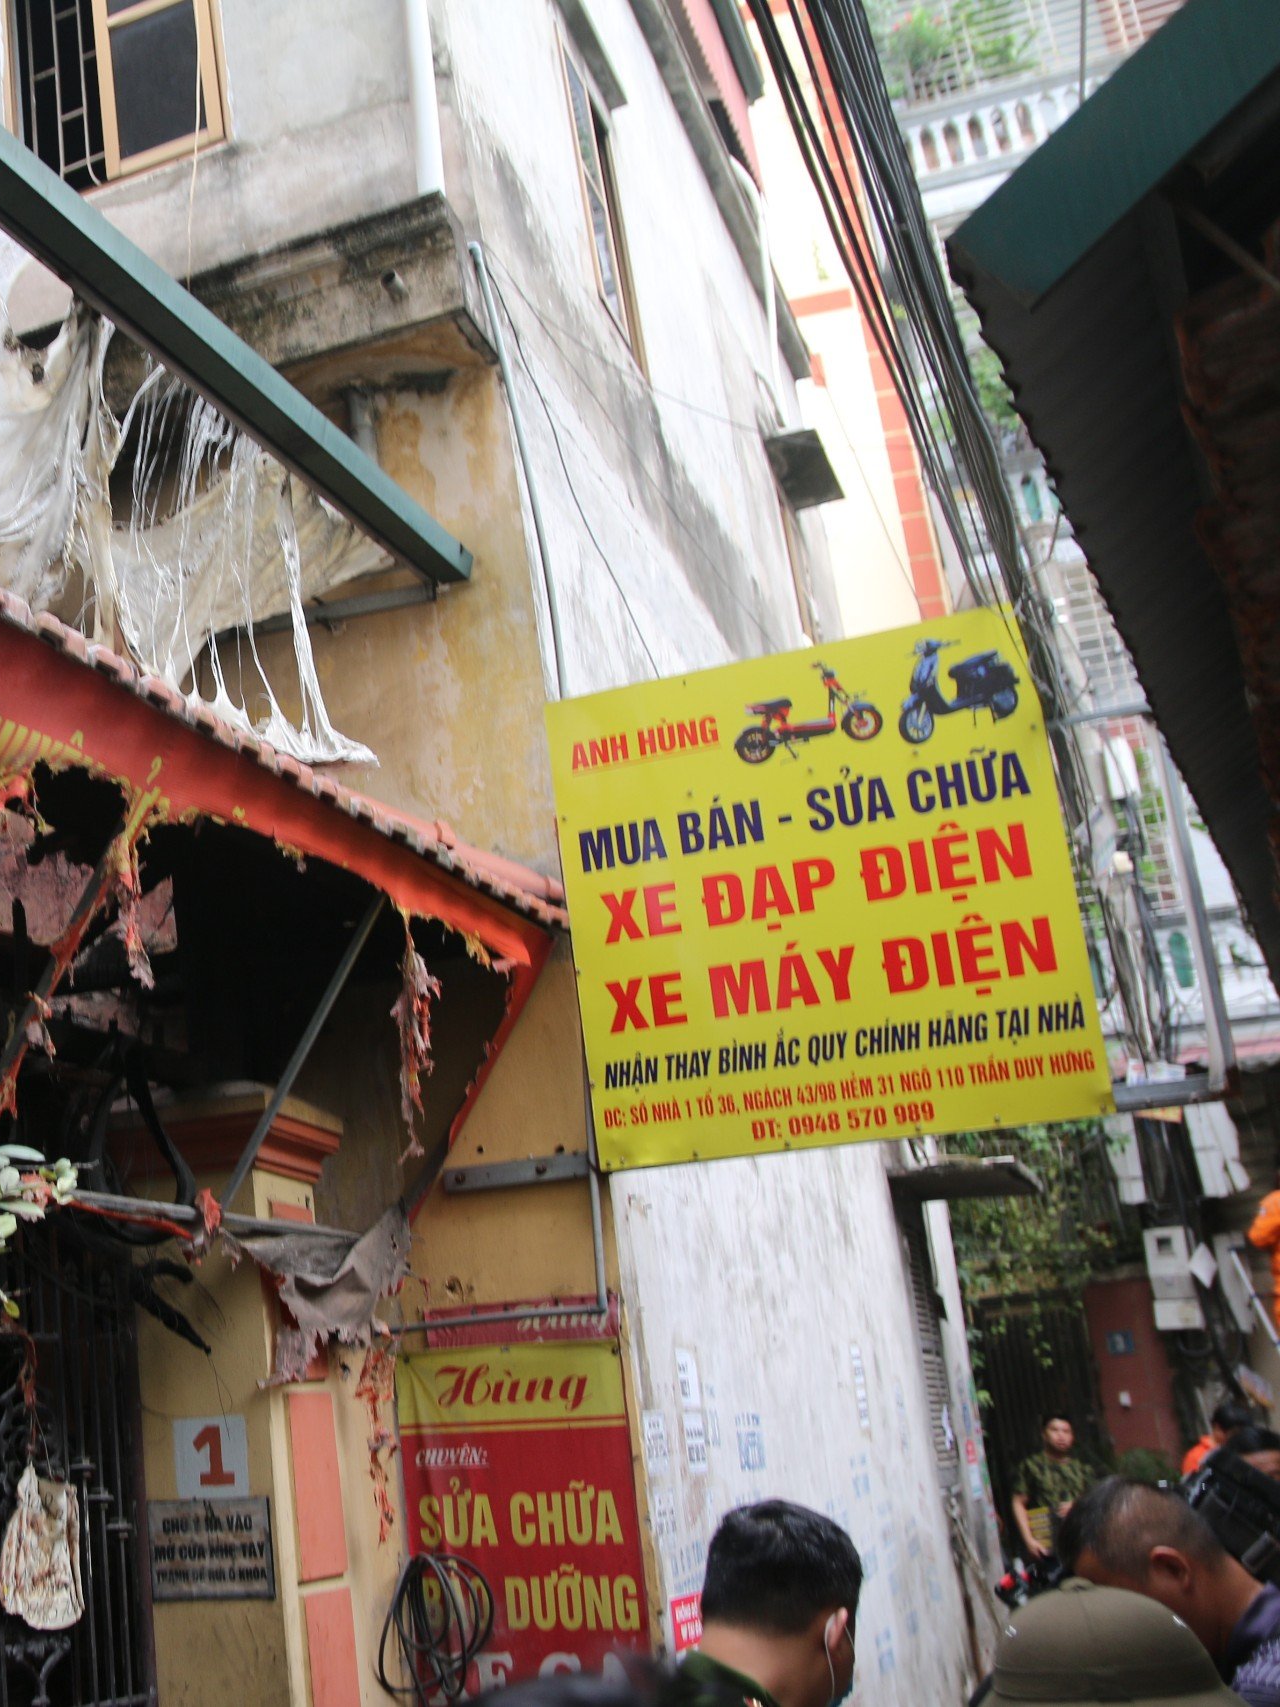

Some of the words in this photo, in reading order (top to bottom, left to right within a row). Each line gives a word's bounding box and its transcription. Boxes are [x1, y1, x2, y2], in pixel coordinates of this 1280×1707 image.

[572, 732, 629, 770] ANH
[637, 716, 719, 758] HÙNG
[579, 819, 667, 873] MUA
[678, 795, 764, 855] BÁN
[806, 766, 895, 831] SỬA
[907, 747, 1031, 813] CHỮA
[600, 882, 682, 944] XE
[701, 857, 835, 931] ĐẠP
[860, 821, 1033, 902] ĐIỆN
[605, 972, 687, 1034] XE
[708, 940, 855, 1018] MÁY
[881, 913, 1059, 996] ĐIỆN
[605, 1052, 658, 1092] NHẬN
[665, 1050, 711, 1082] THAY
[719, 1039, 766, 1074] BÌNH
[774, 1028, 800, 1068] ẮC
[808, 1031, 848, 1063] QUY
[855, 1018, 920, 1057] CHÍNH
[996, 1006, 1029, 1045] TẠI
[1038, 993, 1085, 1034] NHÀ
[652, 1095, 681, 1122] NHÀ
[685, 1099, 691, 1118] 1
[743, 1084, 792, 1111] NGÁCH
[797, 1082, 836, 1104] 43/98
[878, 1074, 894, 1095] 31
[937, 1066, 964, 1088] 110
[1014, 1056, 1043, 1079] DUY
[789, 1112, 840, 1136] 0948
[847, 1106, 887, 1129] 570
[435, 1363, 592, 1412] Hùng
[192, 1424, 235, 1486] 1
[419, 1476, 498, 1547] SỬA
[509, 1480, 624, 1546] CHỮA
[504, 1564, 640, 1632] DƯỠNG
